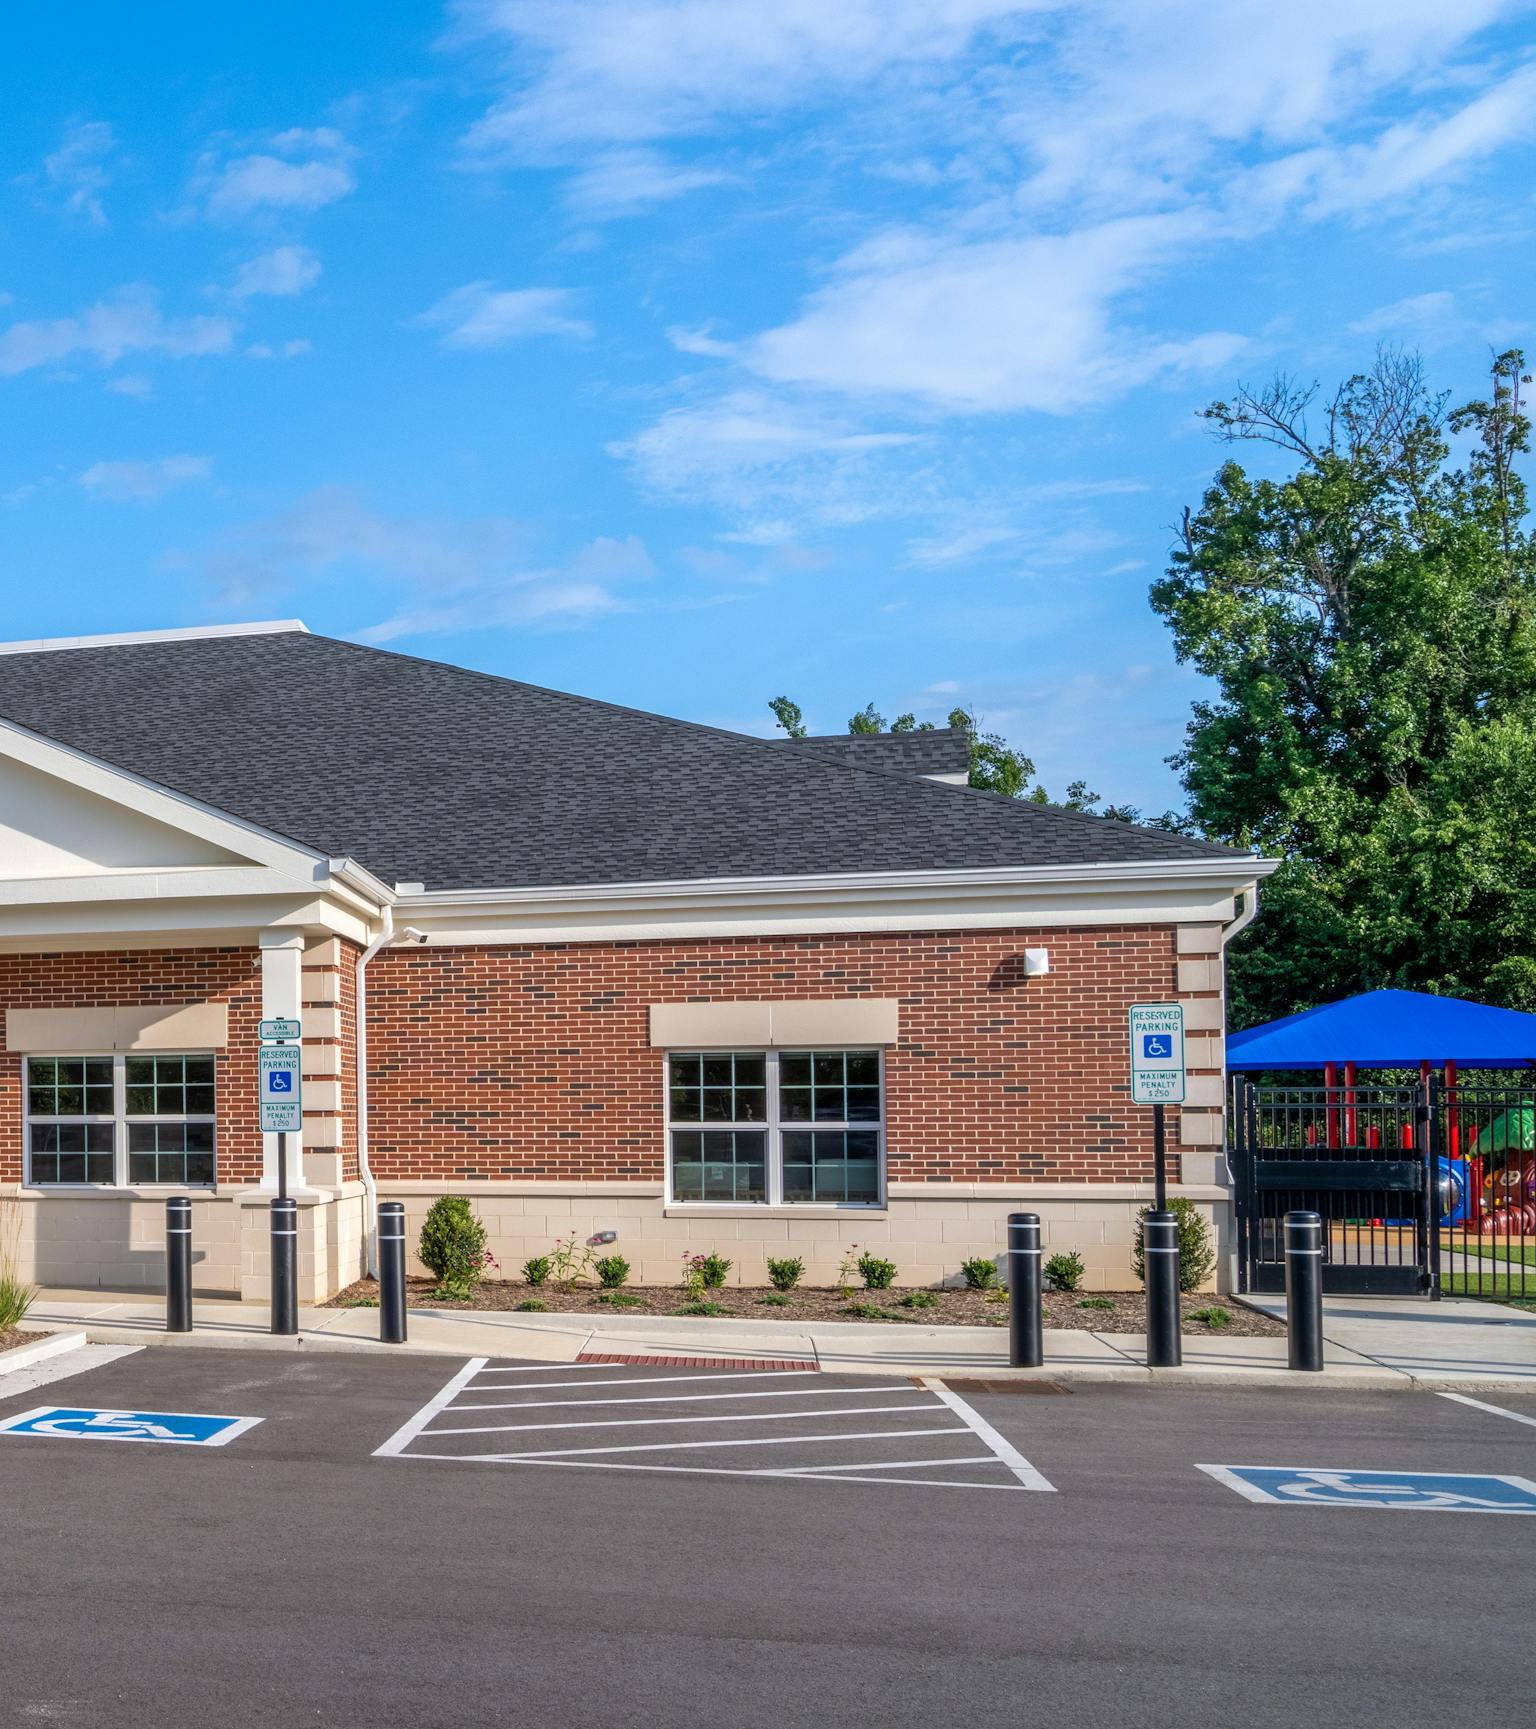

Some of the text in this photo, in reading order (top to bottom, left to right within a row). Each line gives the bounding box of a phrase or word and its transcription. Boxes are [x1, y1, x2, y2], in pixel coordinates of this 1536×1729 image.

[1133, 1010, 1181, 1020] RESERVED
[1135, 1022, 1179, 1032] PARKING
[261, 1050, 298, 1059] RESERVED
[263, 1060, 297, 1069] PARKING
[1139, 1072, 1177, 1080] MAXIMUM
[1141, 1081, 1176, 1089] PENALTY
[1148, 1089, 1170, 1097] $250
